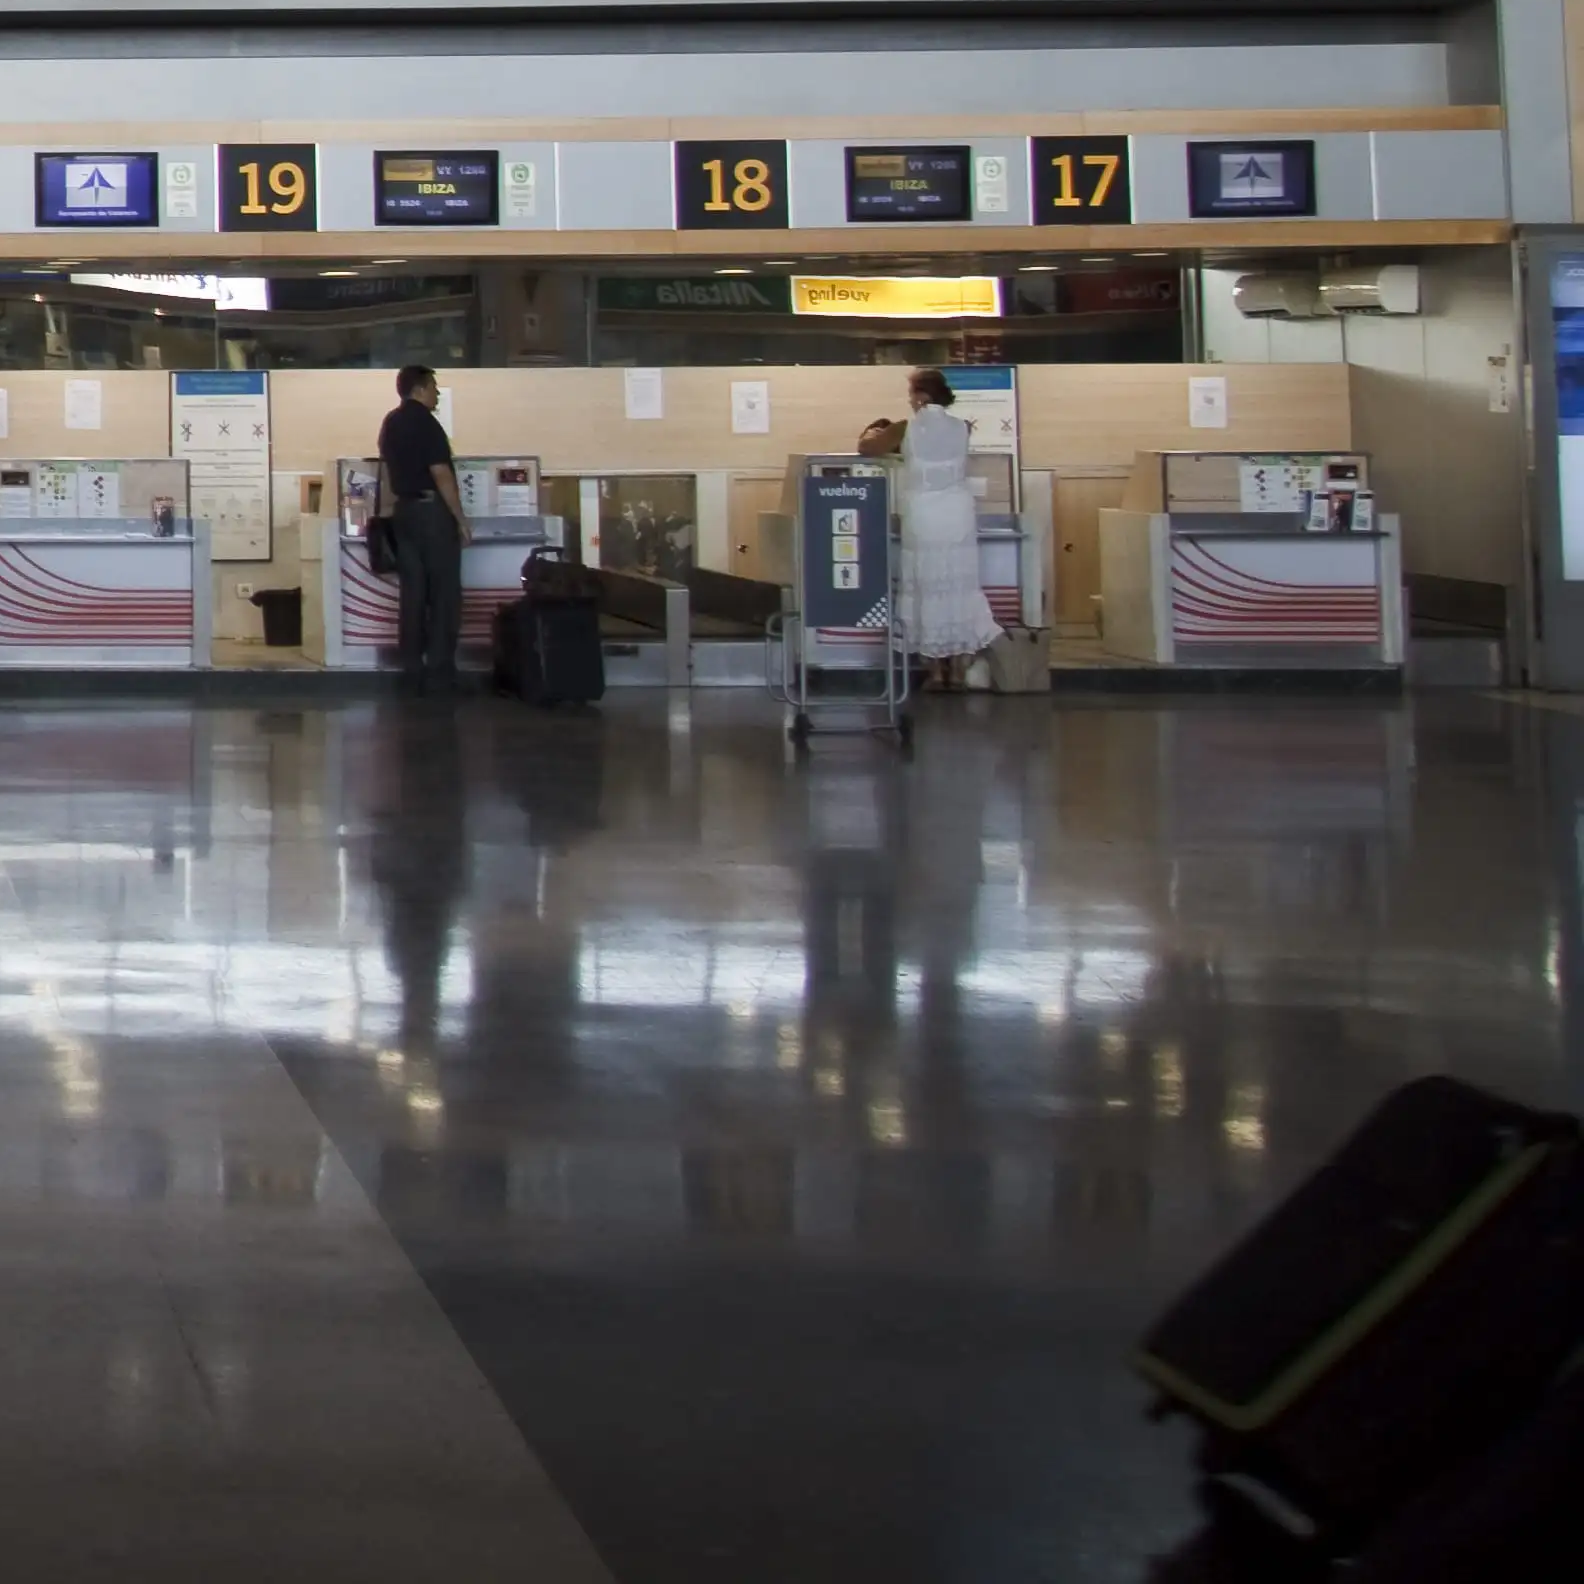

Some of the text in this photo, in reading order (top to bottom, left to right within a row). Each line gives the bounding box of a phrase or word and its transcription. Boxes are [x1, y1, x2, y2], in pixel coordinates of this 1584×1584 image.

[238, 162, 305, 215] 19
[418, 183, 456, 194] IBIZA
[701, 159, 772, 213] 18
[890, 179, 929, 190] IBIZA
[1052, 154, 1119, 208] 17
[818, 482, 868, 501] vueling
